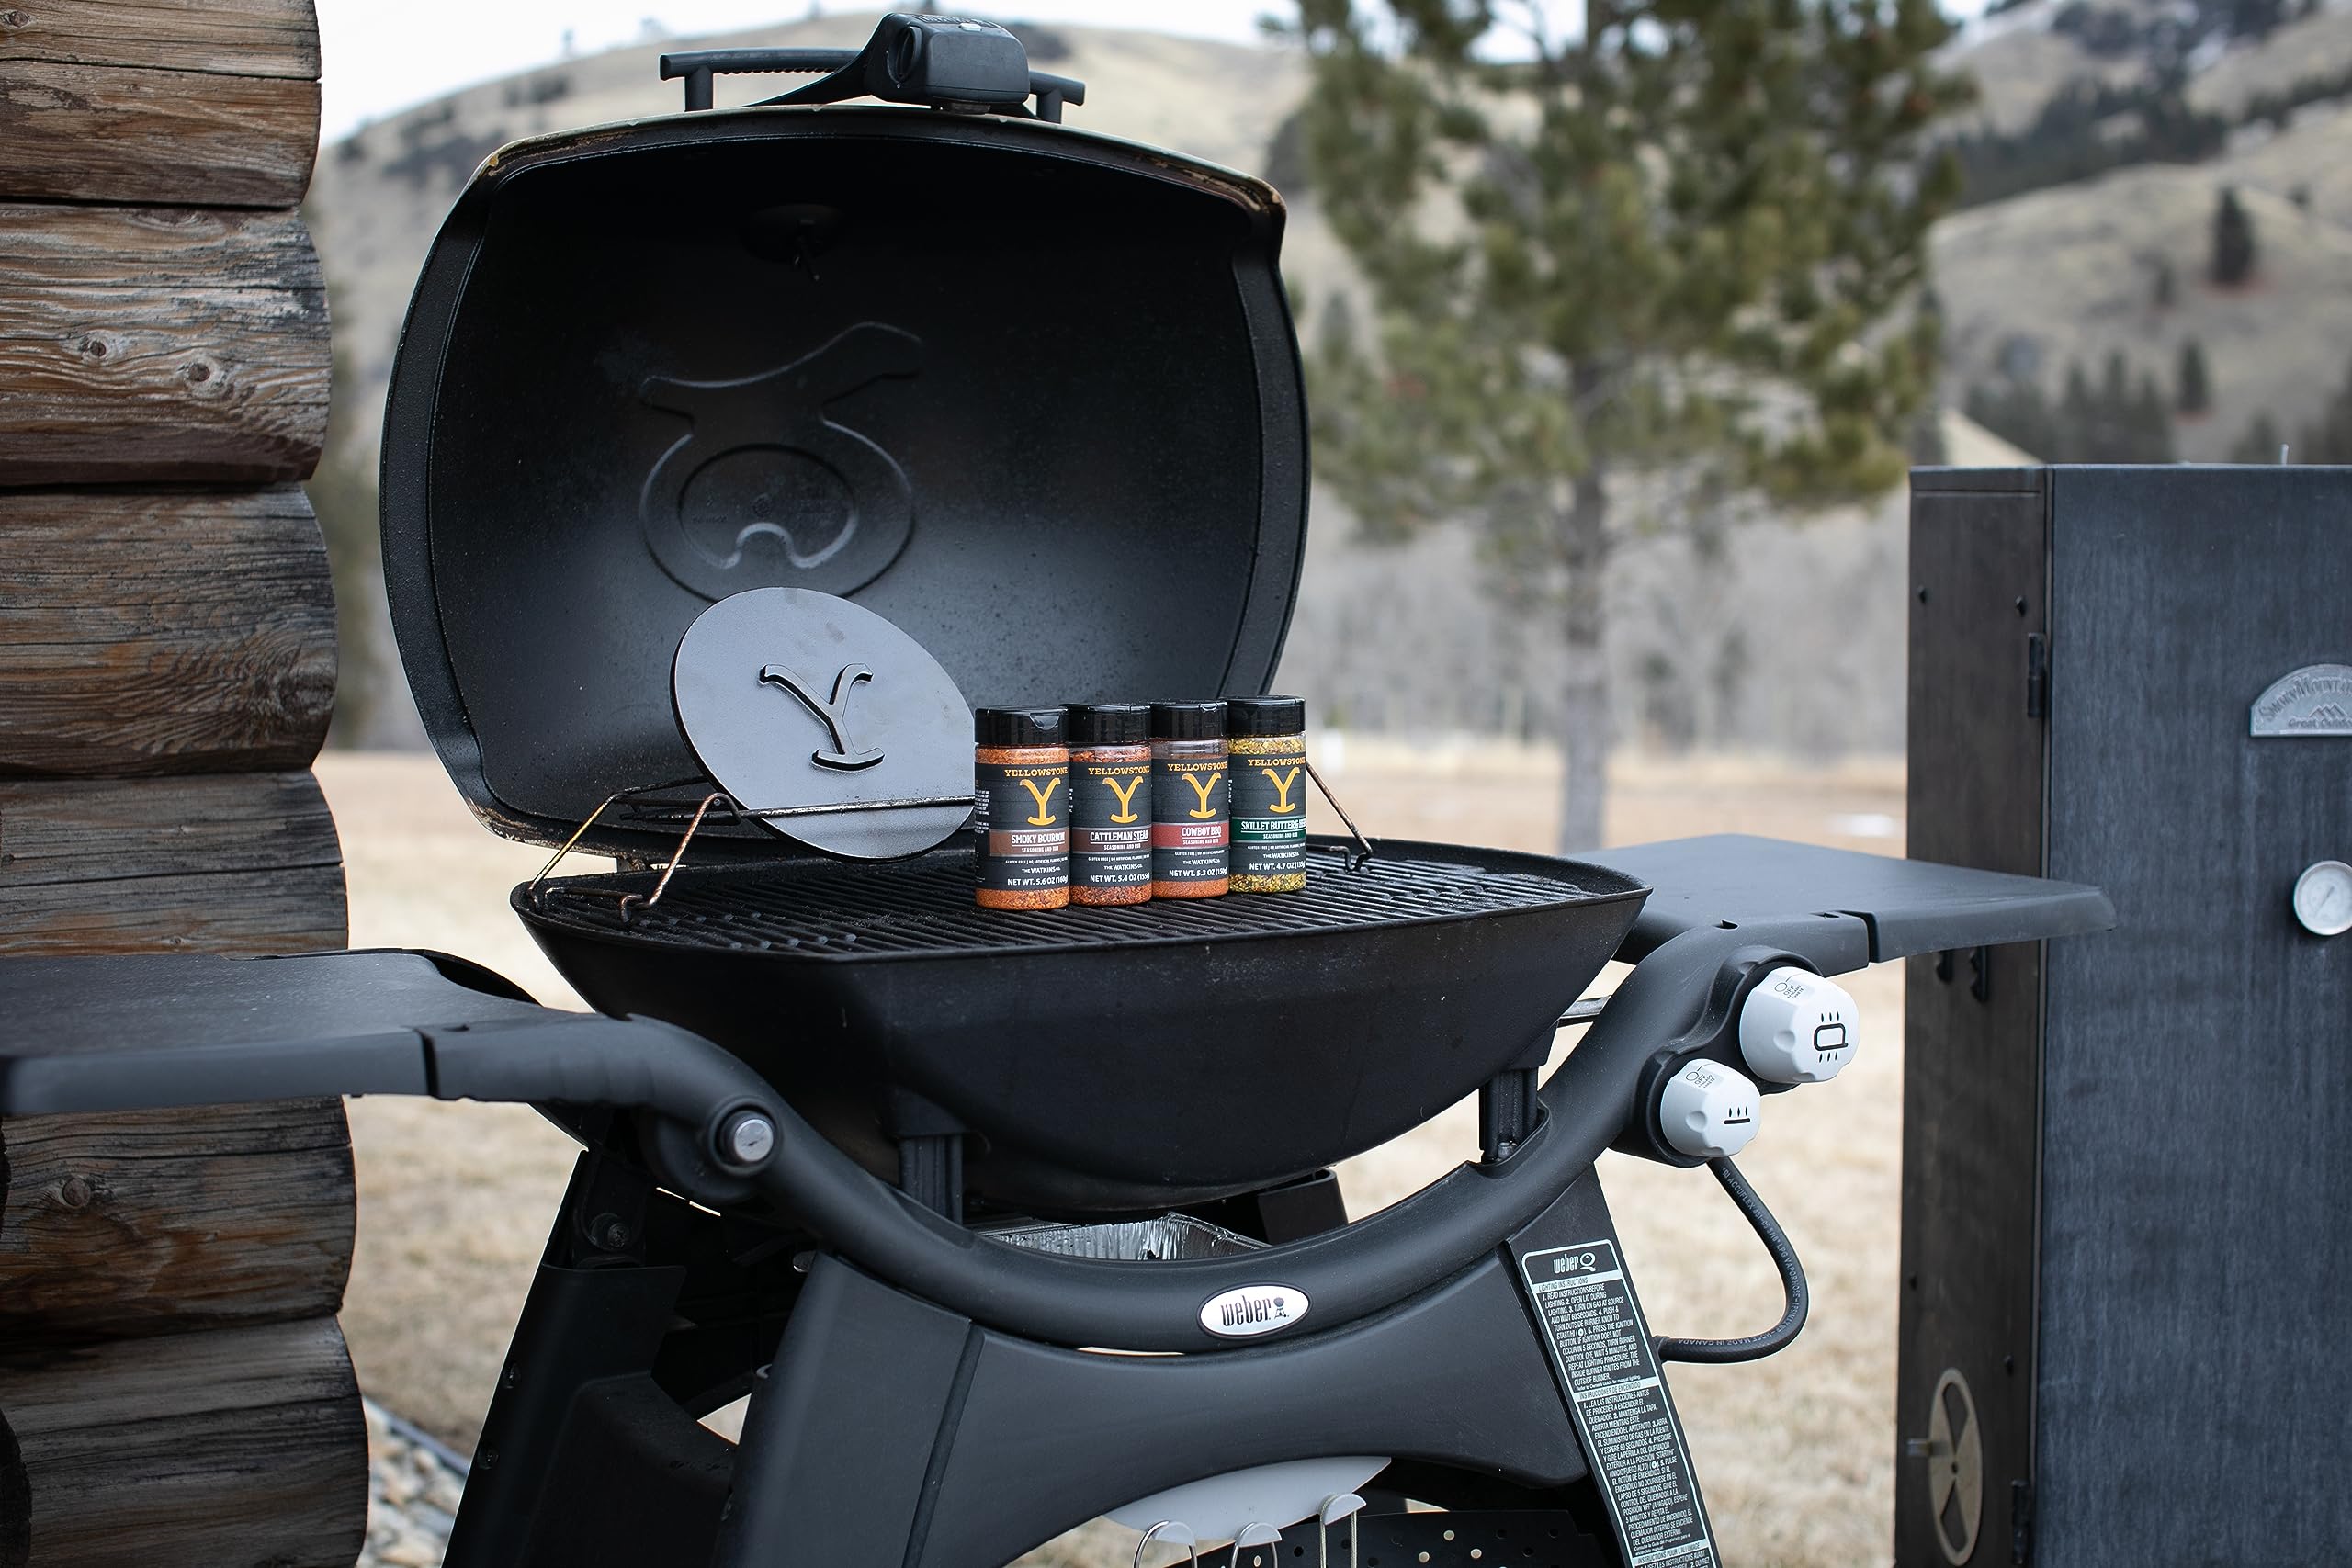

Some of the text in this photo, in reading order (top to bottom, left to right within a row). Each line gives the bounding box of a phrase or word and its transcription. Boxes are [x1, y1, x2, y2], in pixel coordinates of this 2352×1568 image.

[1168, 761, 1227, 771] YELLOWSTONE
[1248, 757, 1306, 766] YELLOWSTONE
[1005, 767, 1068, 776] YELLOWSTONE
[1088, 765, 1150, 775] YELLOWSTONE
[1182, 826, 1221, 837] COWBOY BBQ
[1241, 820, 1298, 830] SKILLET BUTTER &
[1012, 832, 1065, 844] SMOKY BOURBON
[1090, 830, 1148, 841] CATTLEMAN STEAK
[1727, 1178, 1755, 1210] ACCUFLEX
[1776, 1242, 1788, 1257] LPG
[1784, 1257, 1797, 1281] VAPOR
[1553, 1254, 1579, 1274] weber
[1539, 1277, 1588, 1292] LIGHTING INSTRUCTIONS
[1547, 1292, 1558, 1300] READ
[1559, 1286, 1589, 1298] INSTRUCTIONS
[1589, 1283, 1605, 1292] BEFORE
[1571, 1295, 1582, 1304] OPEN
[1590, 1292, 1606, 1301] DURING
[1575, 1303, 1586, 1312] TURN
[1608, 1296, 1624, 1306] SOURCE
[1221, 1295, 1271, 1326] weber
[1551, 1316, 1561, 1325] AND
[1603, 1306, 1614, 1314] PUSH
[1555, 1324, 1566, 1332] TURN
[1566, 1320, 1584, 1330] OUTSIDE
[1585, 1317, 1600, 1326] BURNER
[1602, 1314, 1612, 1323] KNOB
[1593, 1324, 1607, 1333] PRESS
[1616, 1319, 1634, 1329] IGNITION
[1582, 1334, 1600, 1343] IGNITION
[1601, 1331, 1611, 1339] DOES
[1613, 1329, 1622, 1337] NOT
[1563, 1347, 1577, 1355] OCCUR
[1608, 1338, 1619, 1347] TURN
[1619, 1336, 1635, 1345] BURNER
[1566, 1353, 1584, 1363] CONTROL
[1594, 1349, 1605, 1358] WAIT
[1628, 1343, 1637, 1351] AND
[1568, 1361, 1584, 1371] REPEAT
[1585, 1358, 1603, 1368] LIGHTING
[1571, 1369, 1586, 1379] INSIDE
[1586, 1366, 1602, 1375] BURNER
[1603, 1362, 1619, 1372] IGNITES
[1620, 1360, 1632, 1369] FROM
[1574, 1376, 1592, 1386] OUTSIDE
[1580, 1387, 1611, 1400] INSTRUCCIONES
